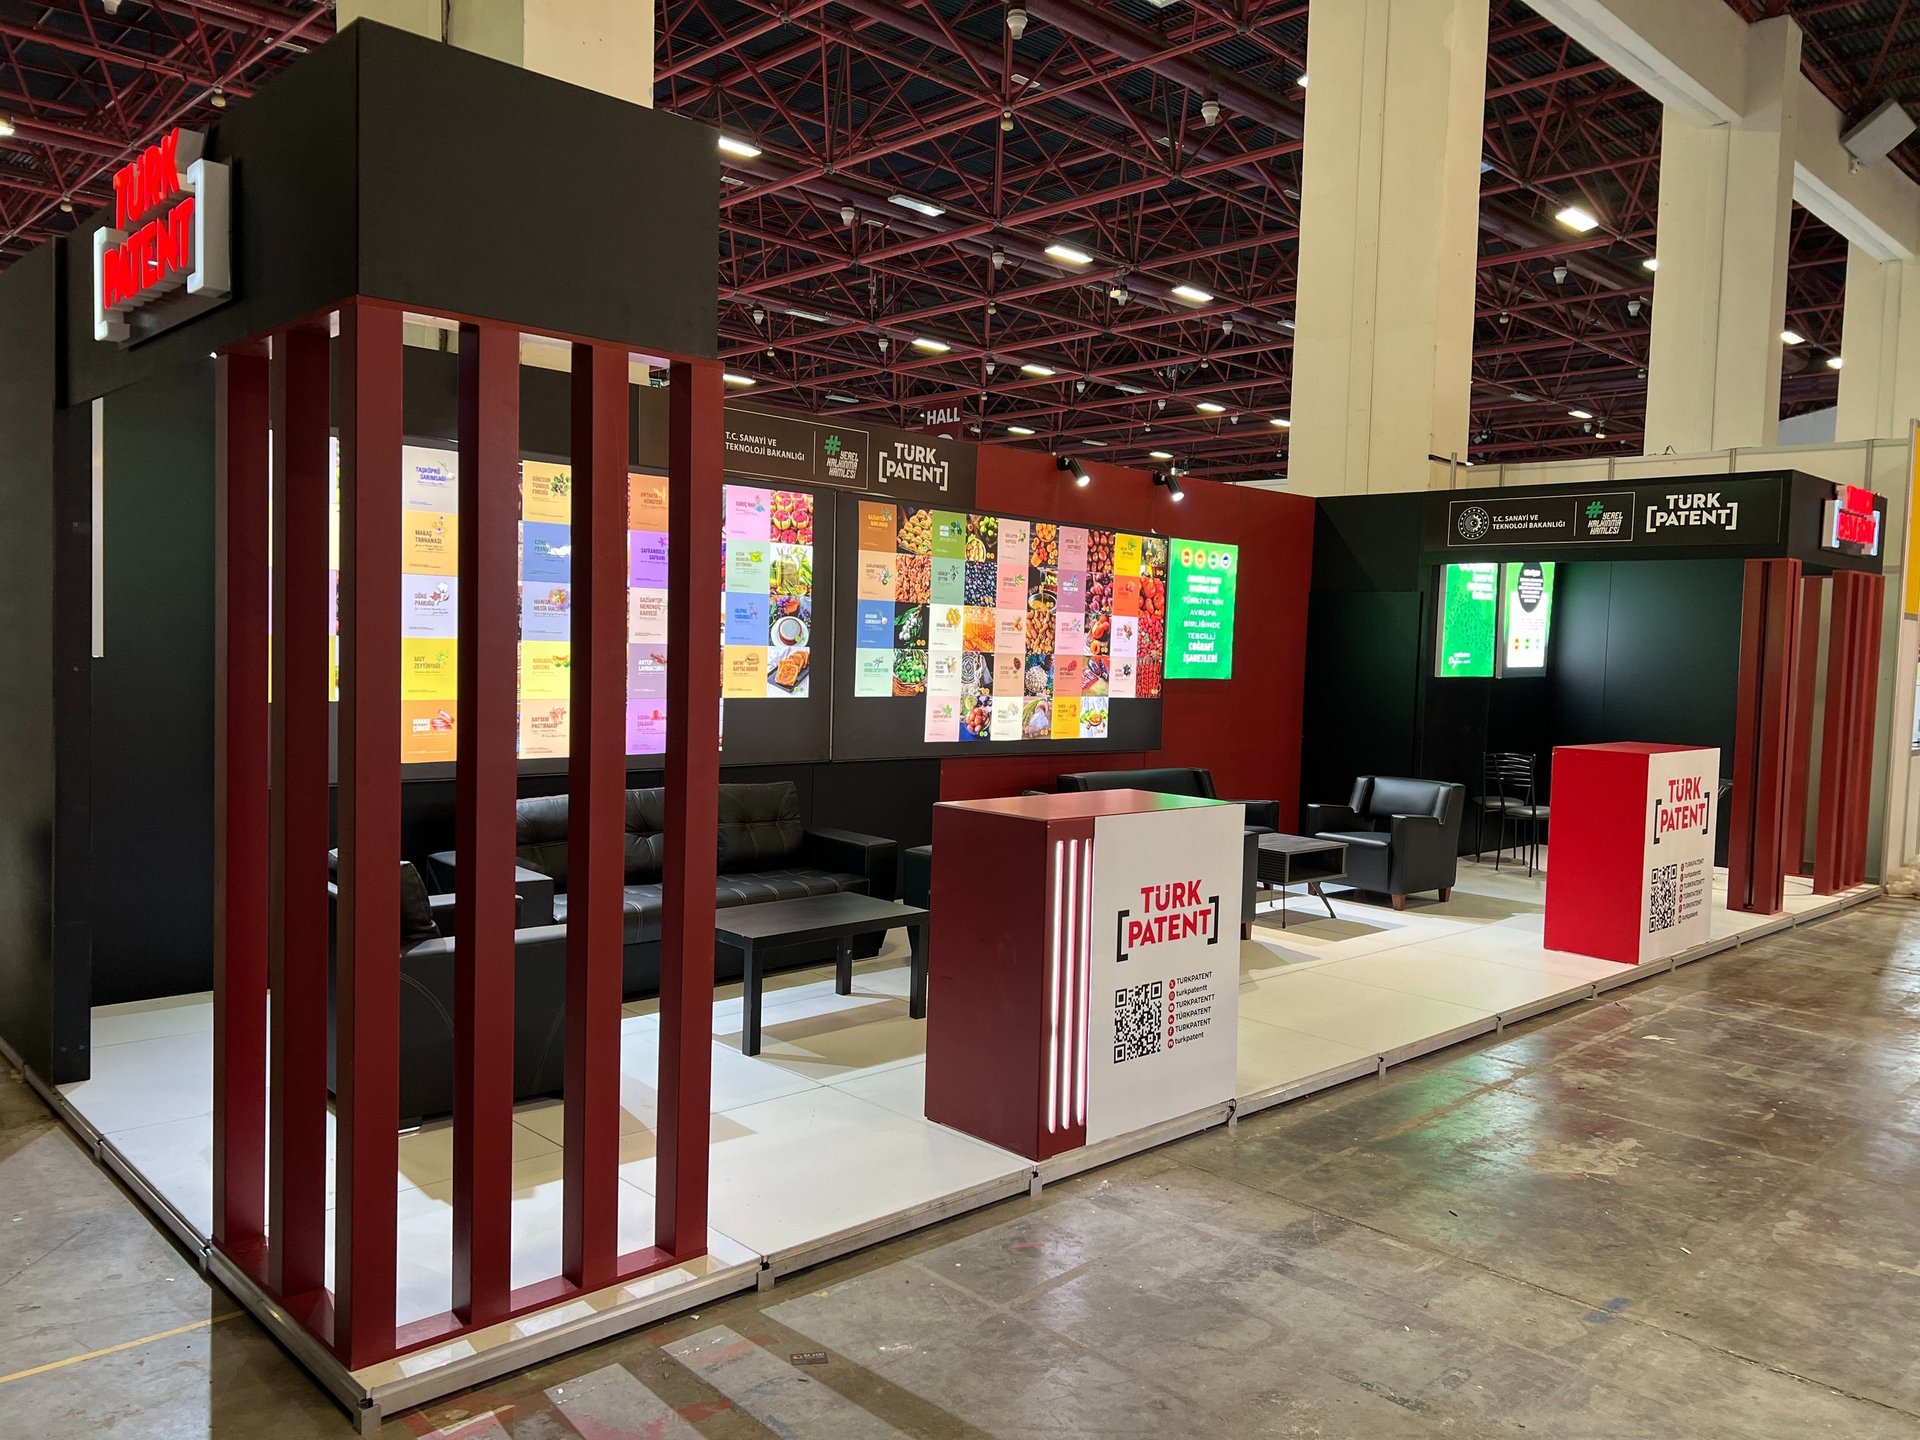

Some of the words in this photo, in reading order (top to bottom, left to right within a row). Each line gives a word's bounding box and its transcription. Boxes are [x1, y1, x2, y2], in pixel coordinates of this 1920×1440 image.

[103, 197, 194, 309] PATENT
[927, 407, 960, 425] HALL
[725, 431, 738, 441] T.C.
[740, 433, 766, 445] SANAYİ
[767, 438, 777, 447] VE
[725, 442, 766, 456] TEKNOLOJİ
[766, 450, 805, 461] BAKANLIĞI
[886, 459, 943, 484] PATENT
[1492, 522, 1528, 530] TEKNOLOJİ
[1529, 520, 1566, 528] BAKANLIĞI
[1493, 515, 1504, 523] T.C.
[1505, 513, 1529, 522] SANAYİ
[1655, 508, 1731, 527] PATENT
[1190, 609, 1217, 617] AVRUPA
[1668, 775, 1702, 803] TÜRK
[1659, 802, 1706, 834] PATENT
[1140, 879, 1202, 914] TÜRK
[1128, 908, 1212, 949] PATENT
[1176, 971, 1213, 985] TURKPATENT
[1176, 984, 1208, 997] turkpatentt
[1176, 993, 1216, 1009] TURKPATENTT
[1175, 1018, 1212, 1033] TURKPATENT
[1174, 1032, 1204, 1045] turkpatent
